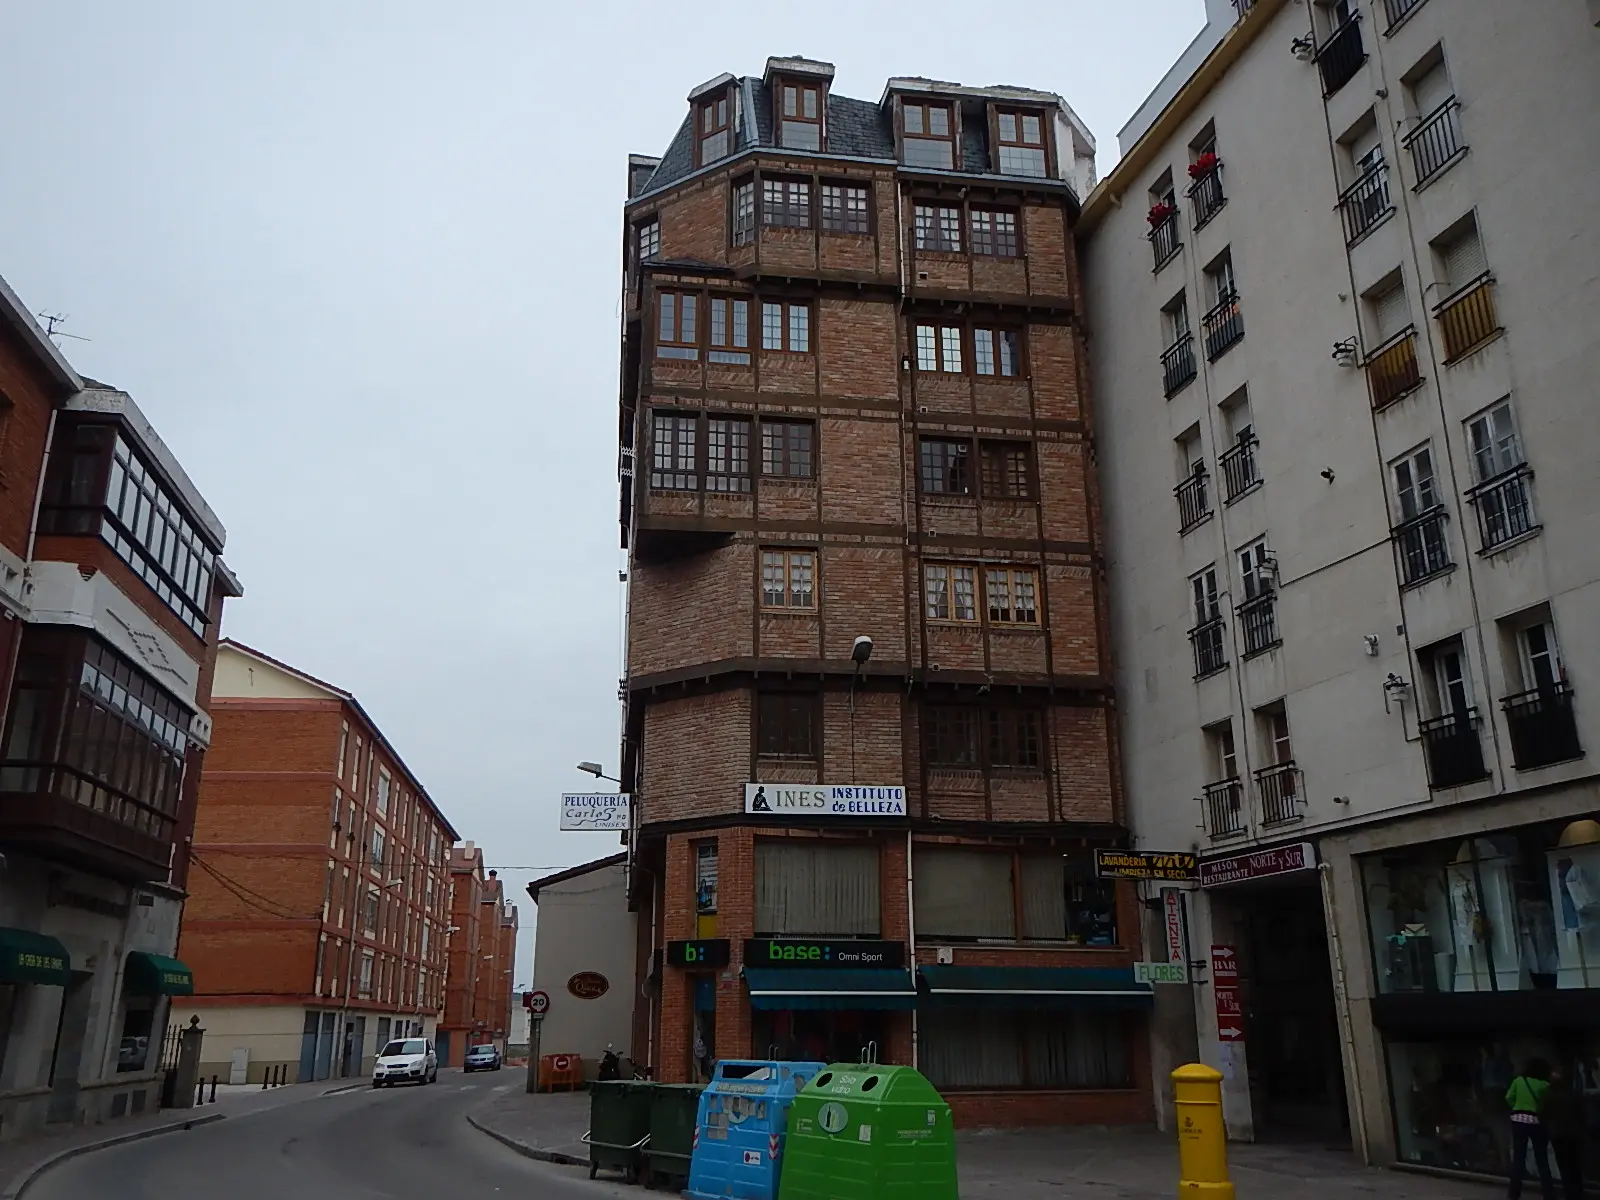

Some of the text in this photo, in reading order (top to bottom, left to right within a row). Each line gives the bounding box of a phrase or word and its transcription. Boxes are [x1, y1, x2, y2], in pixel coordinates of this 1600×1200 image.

[776, 790, 826, 808] INES
[832, 787, 903, 800] INSTITUTO
[564, 795, 628, 808] PELUQUERÍA
[832, 800, 903, 813] de BELLEZA
[1099, 855, 1148, 867] LAVANDERIA
[1249, 852, 1277, 876] NORTE
[1284, 849, 1304, 867] SUR
[1166, 869, 1187, 879] SECO
[1203, 868, 1249, 885] RESTAURANTE
[1166, 890, 1182, 961] ATENEA
[838, 952, 860, 962] Omni
[861, 952, 883, 963] Sport
[1214, 960, 1237, 970] BAR
[1139, 965, 1185, 982] FLORES
[532, 998, 545, 1007] 20
